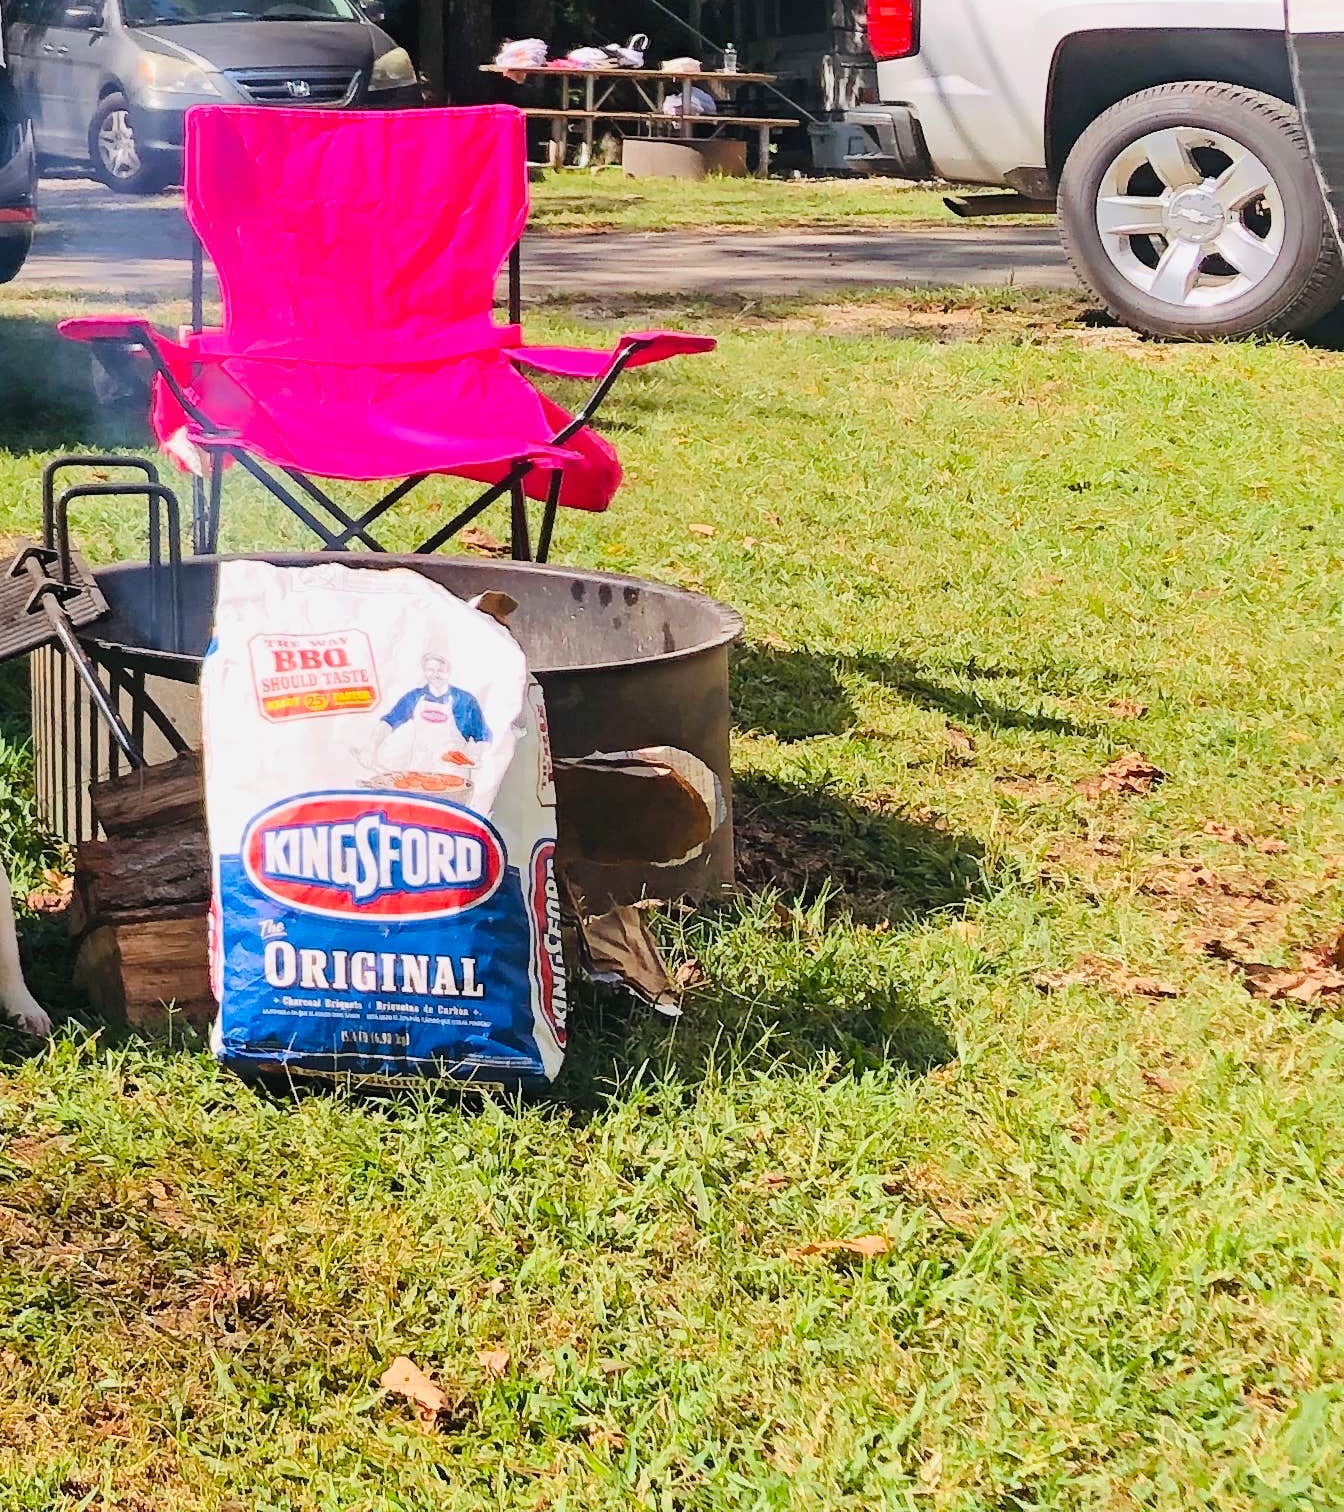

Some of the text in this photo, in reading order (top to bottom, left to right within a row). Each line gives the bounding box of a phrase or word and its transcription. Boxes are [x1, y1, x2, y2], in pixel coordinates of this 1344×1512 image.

[272, 648, 352, 672] BBQ
[261, 668, 369, 693] SHOULD TASTE
[264, 814, 483, 898] KINGSFORD
[258, 919, 287, 938] The
